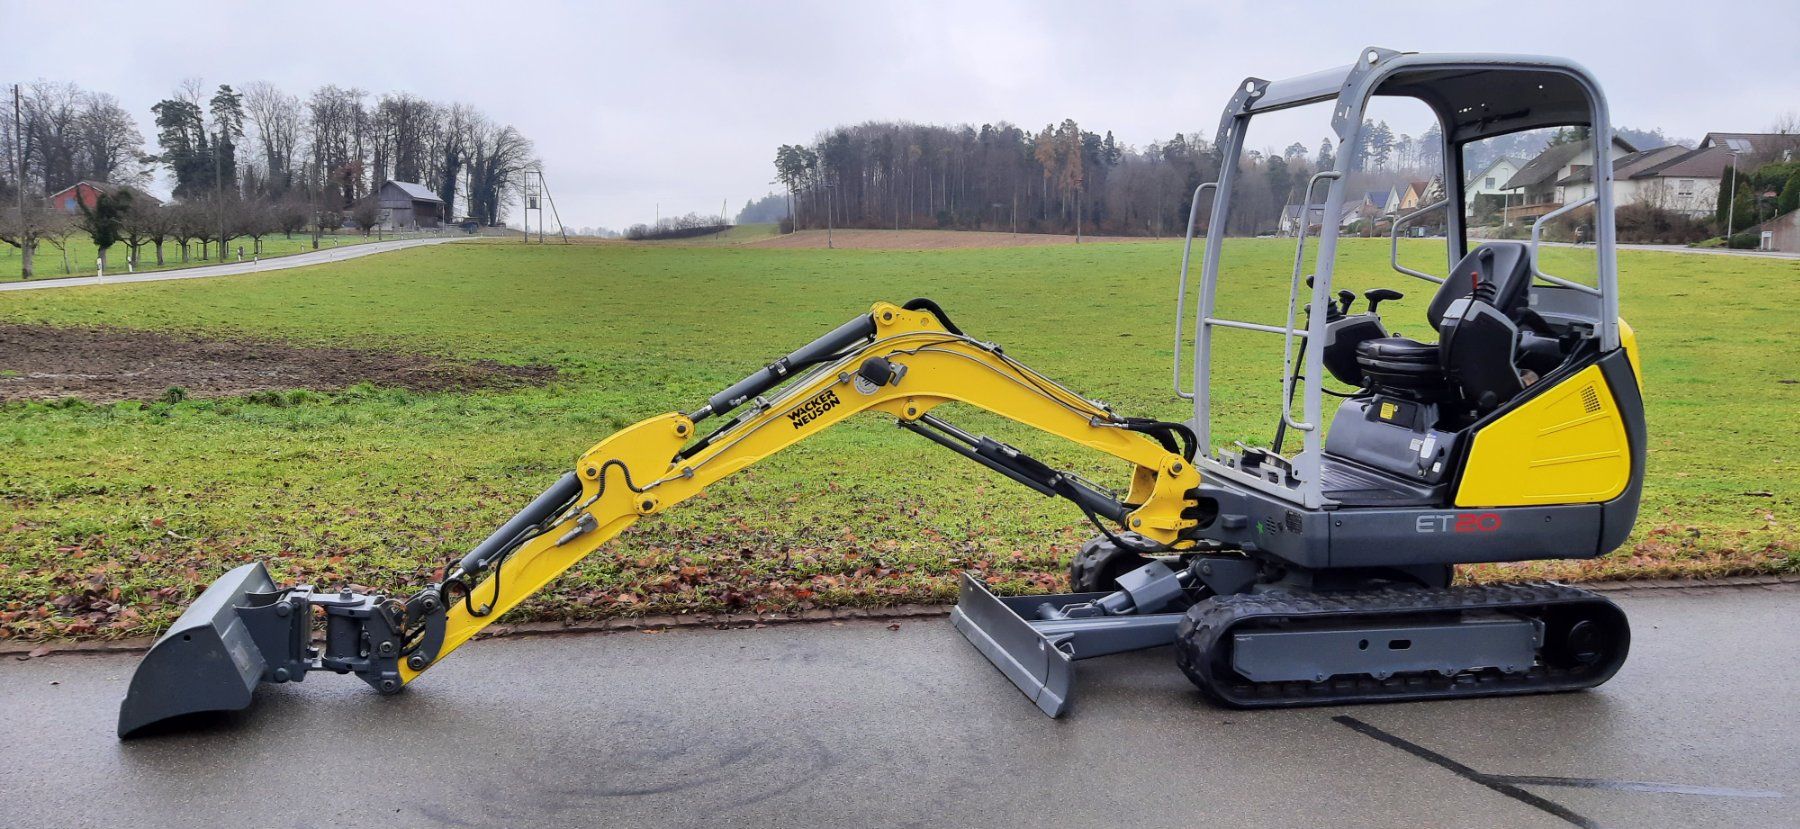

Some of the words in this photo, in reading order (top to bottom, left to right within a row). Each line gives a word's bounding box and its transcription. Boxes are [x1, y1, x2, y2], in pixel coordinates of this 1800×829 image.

[787, 390, 836, 420] WACKER
[793, 397, 841, 429] NEUSON
[1416, 513, 1502, 532] ET20
